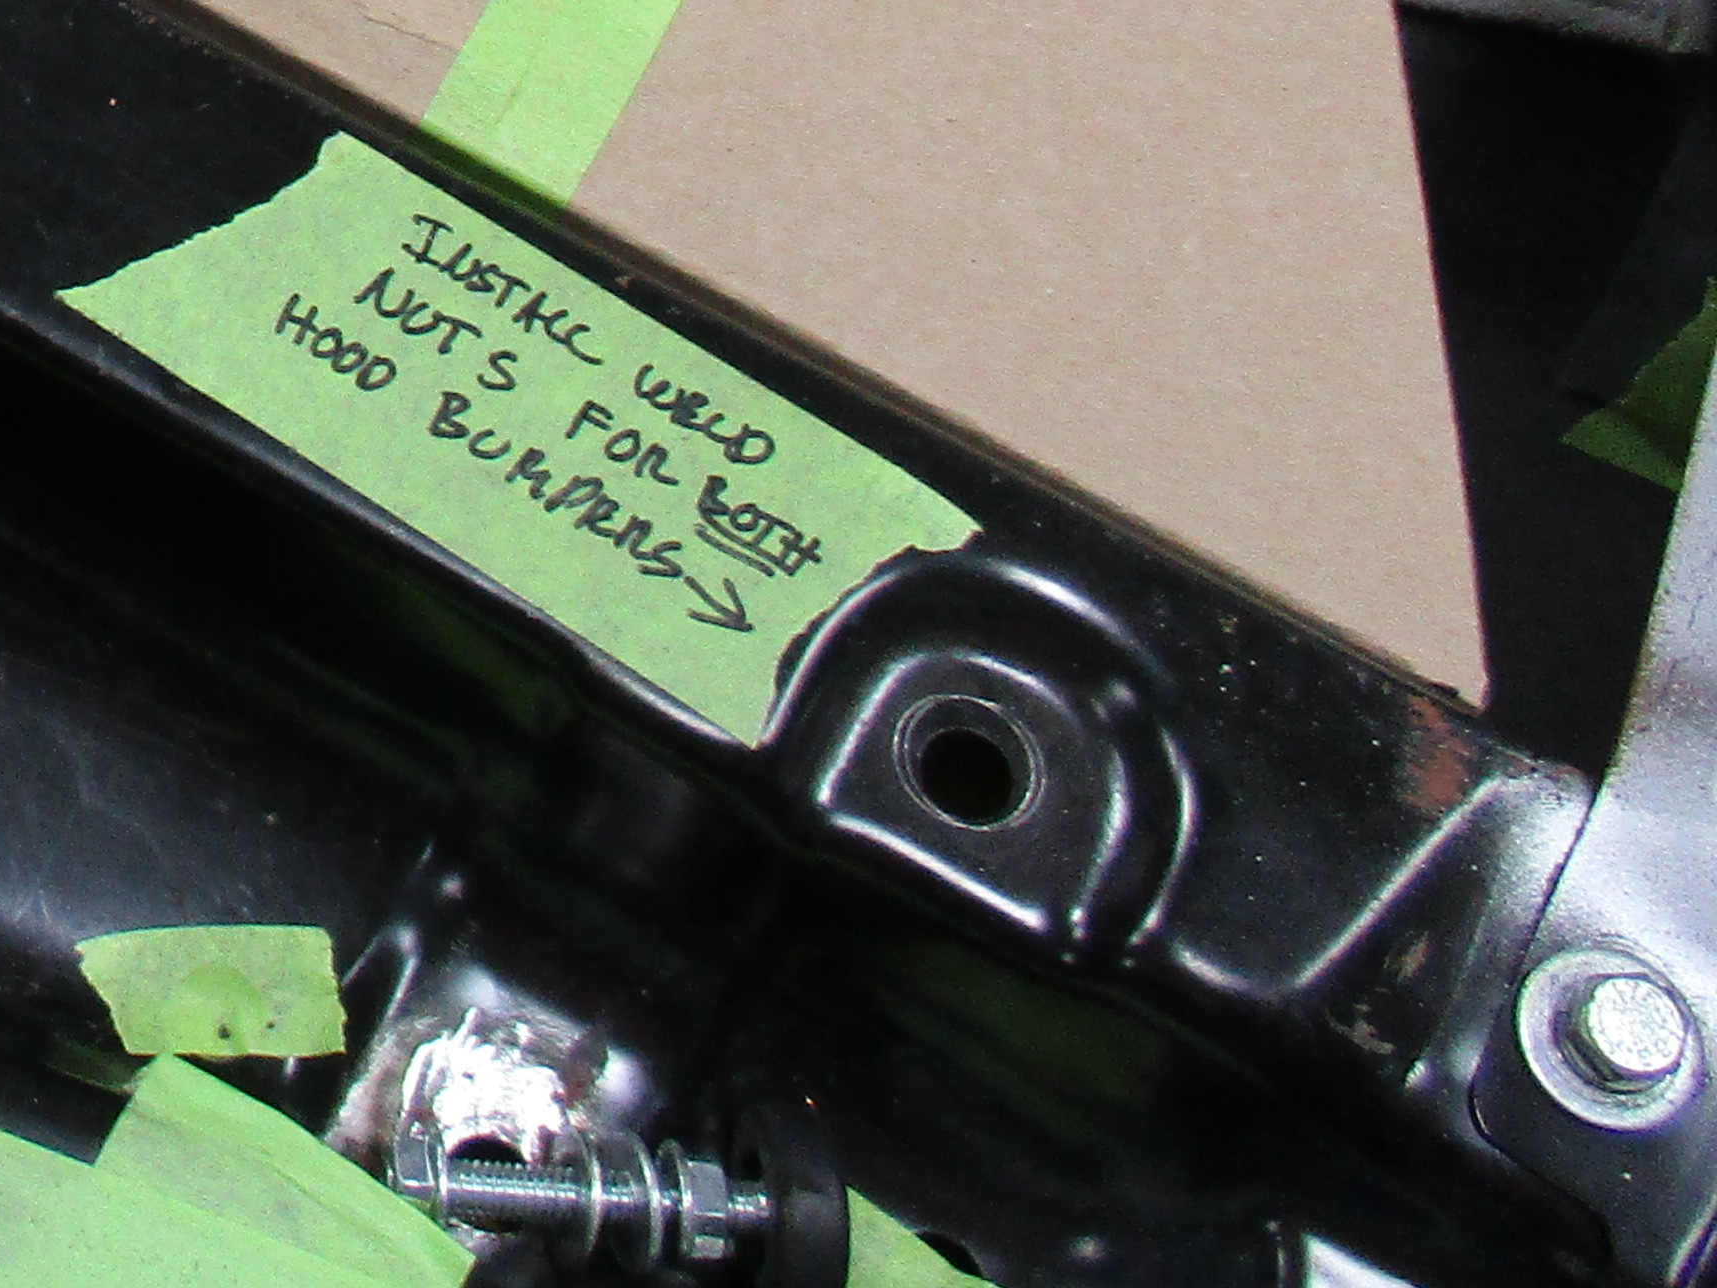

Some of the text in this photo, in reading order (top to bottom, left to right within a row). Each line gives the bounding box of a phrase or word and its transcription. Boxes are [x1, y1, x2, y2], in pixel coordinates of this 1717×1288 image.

[275, 292, 398, 392] HOOD
[401, 213, 605, 366] INSTALL
[565, 399, 680, 486] FOR
[696, 473, 823, 577] BOTH
